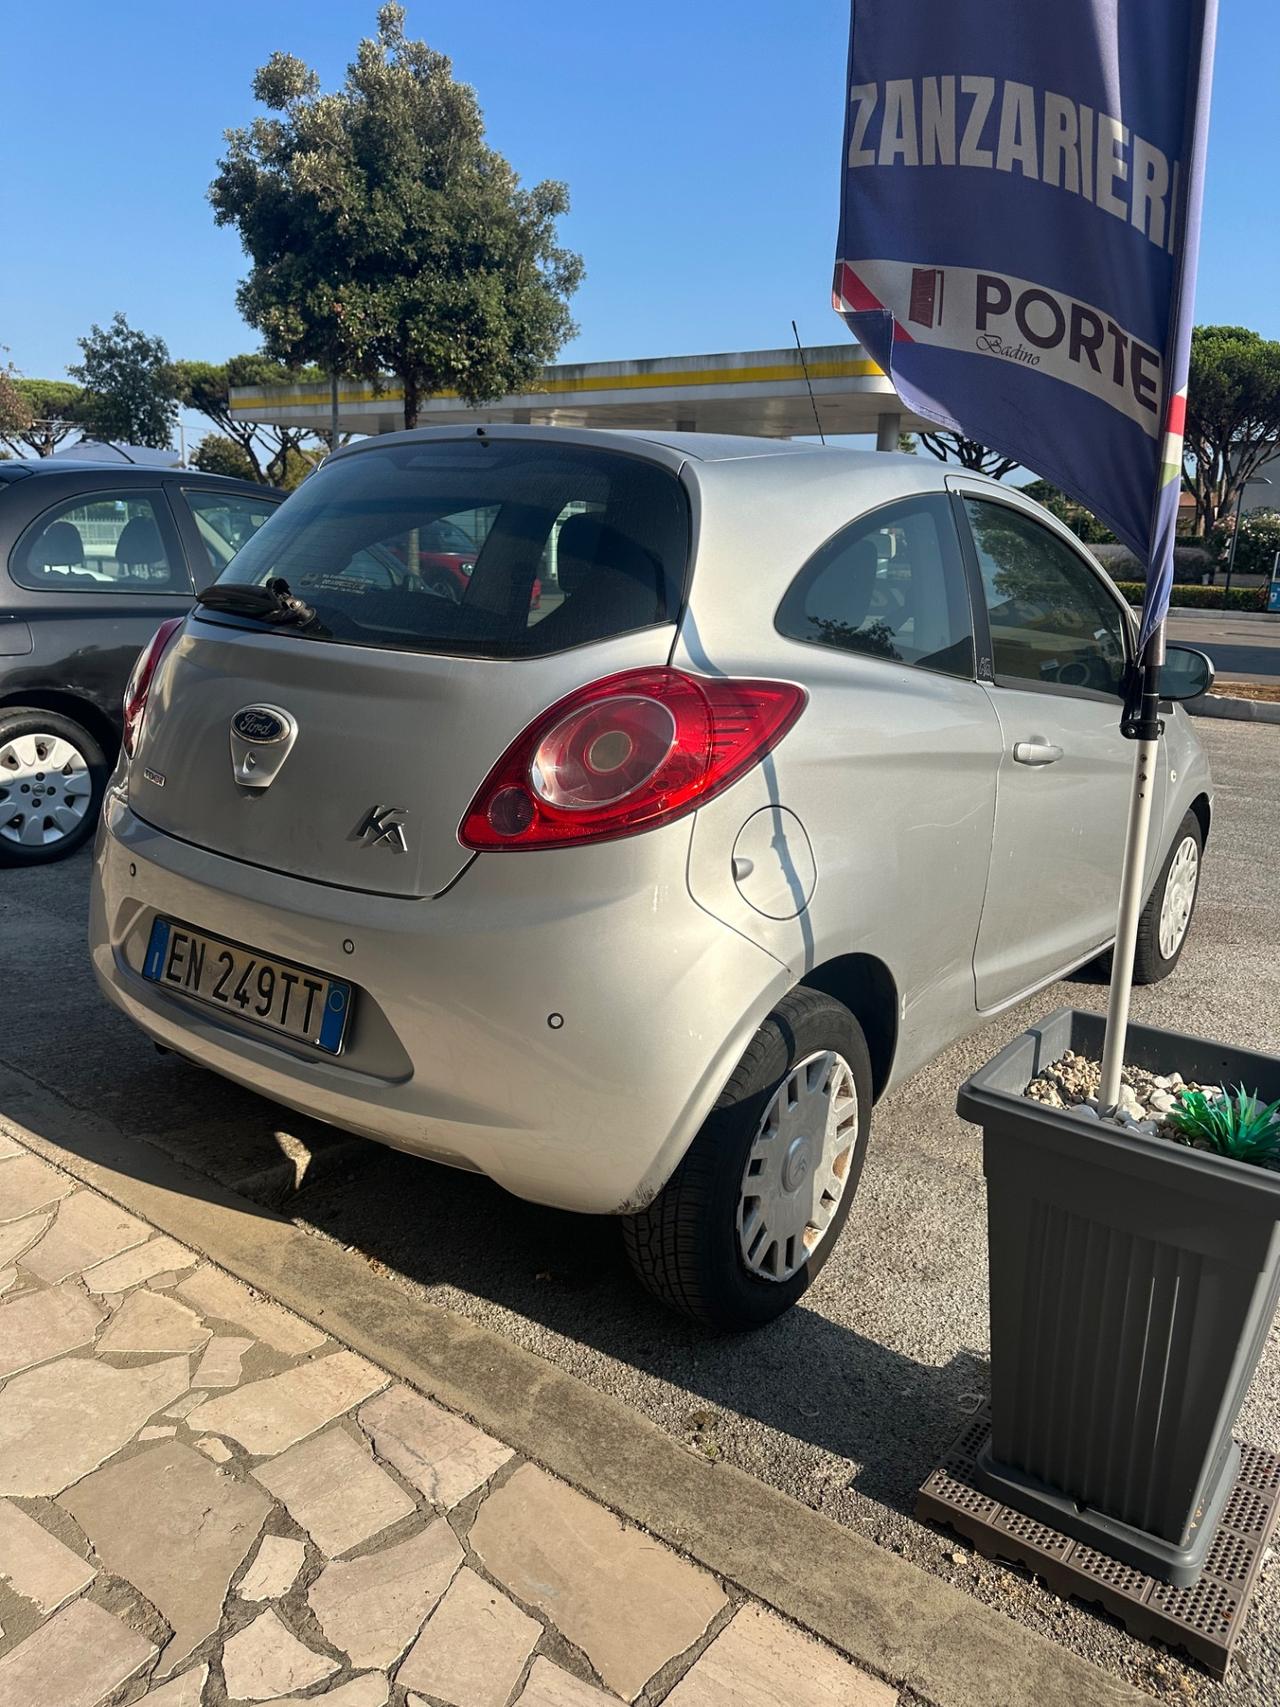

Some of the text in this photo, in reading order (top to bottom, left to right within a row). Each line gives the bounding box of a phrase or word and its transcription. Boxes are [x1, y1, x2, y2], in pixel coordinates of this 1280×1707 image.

[975, 274, 1160, 415] PORTE
[976, 333, 1040, 366] Badino
[239, 712, 273, 735] Ford
[166, 932, 206, 991] EN
